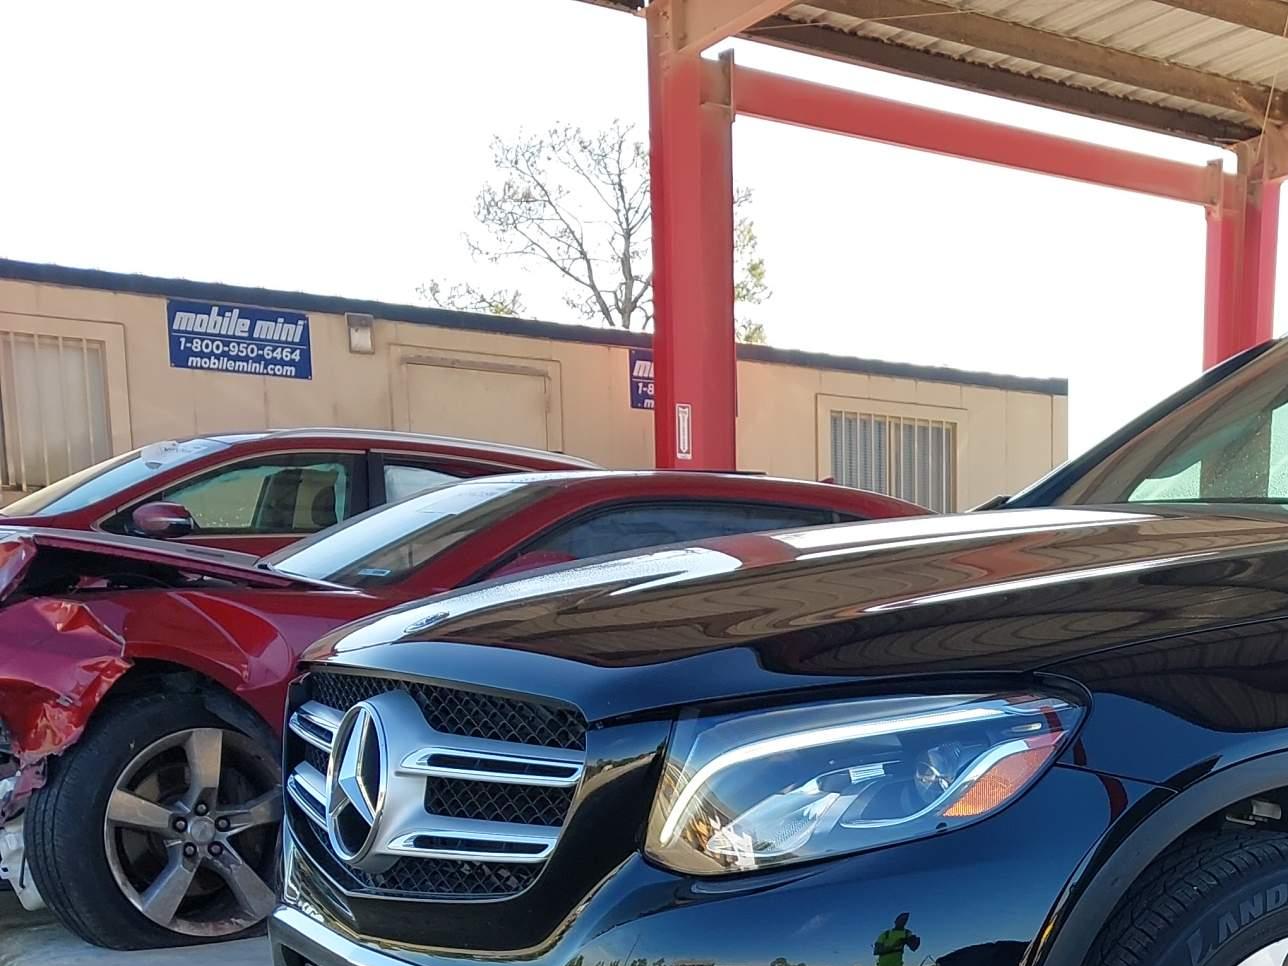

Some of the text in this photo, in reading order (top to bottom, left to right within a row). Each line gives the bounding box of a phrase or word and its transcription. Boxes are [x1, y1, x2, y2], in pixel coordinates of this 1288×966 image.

[172, 306, 304, 342] mobile mini
[179, 337, 300, 362] 1-800-950-6464
[187, 356, 296, 376] mobilemini.com
